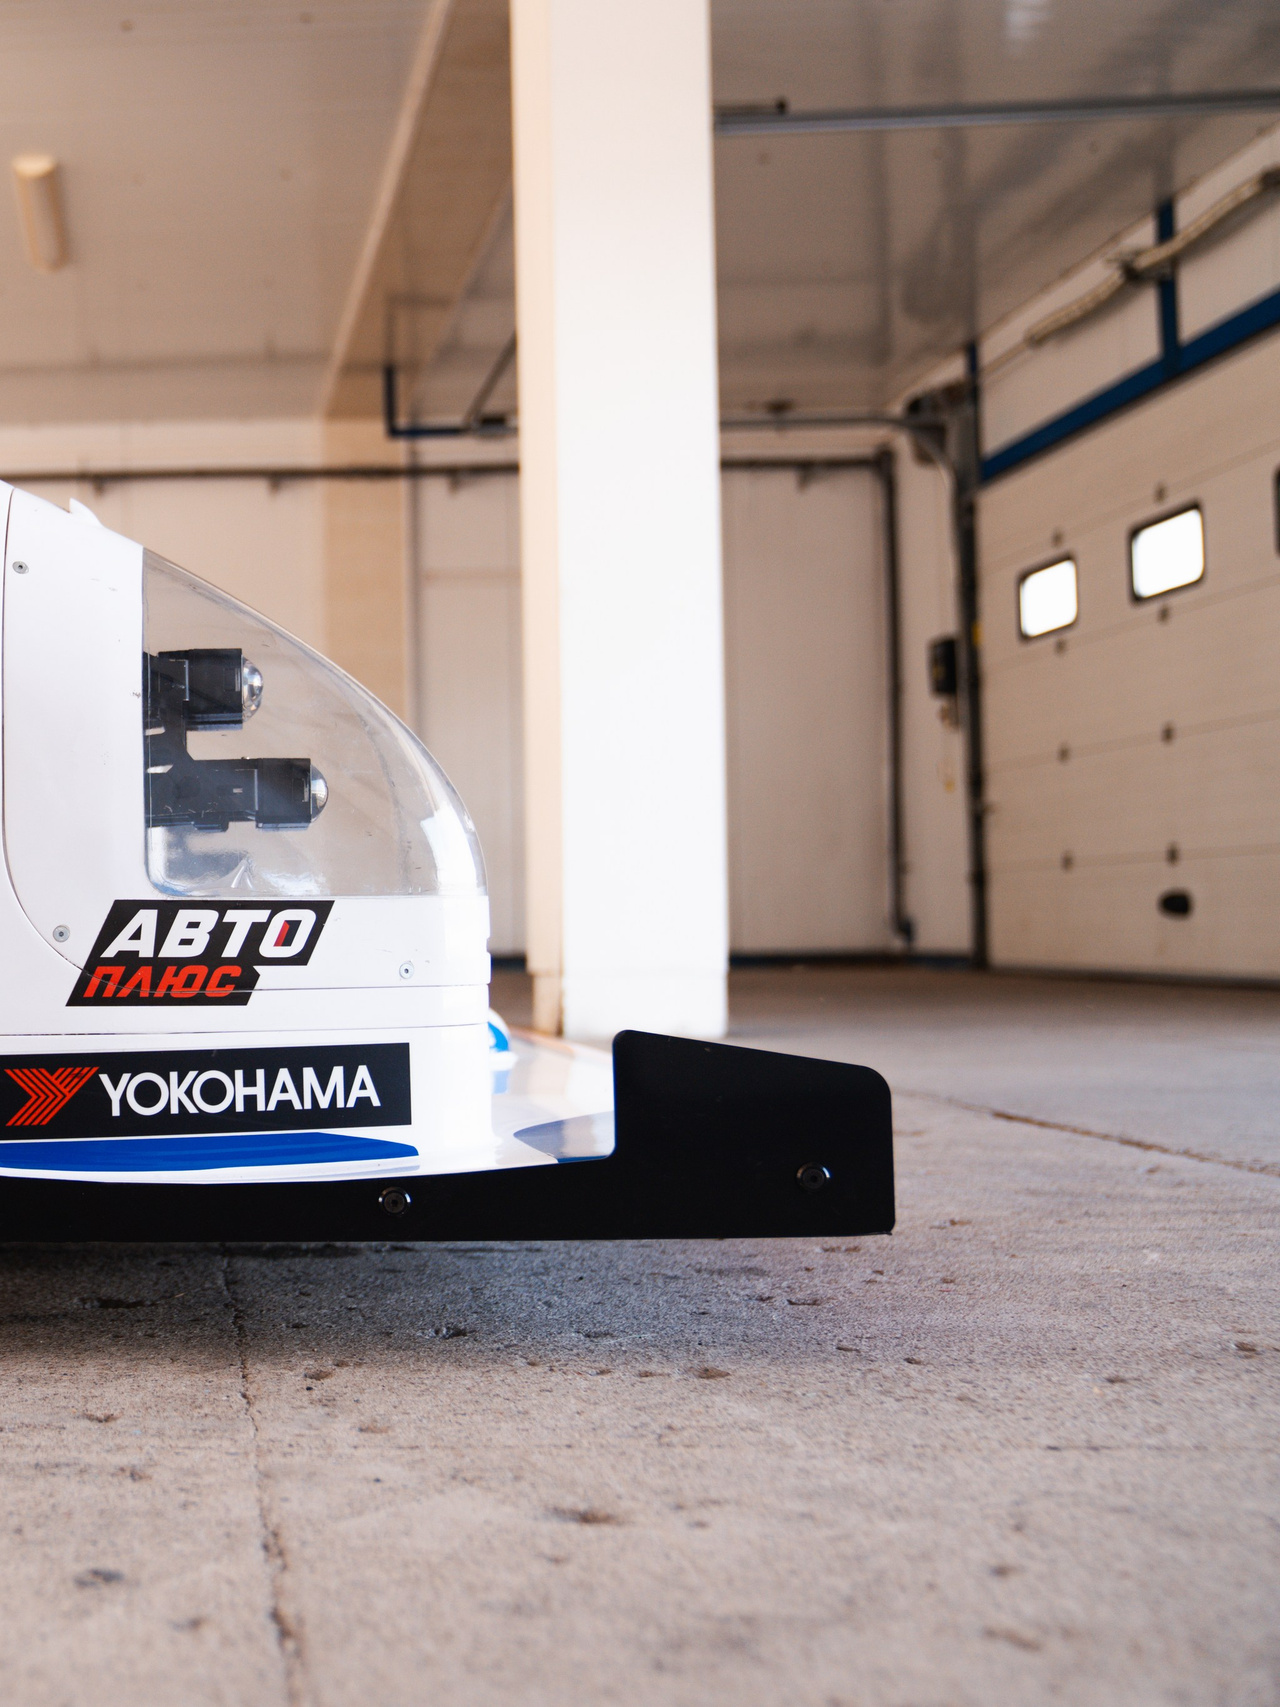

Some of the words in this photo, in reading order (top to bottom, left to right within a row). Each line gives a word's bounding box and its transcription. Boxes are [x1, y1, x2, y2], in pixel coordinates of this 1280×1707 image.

[100, 908, 317, 958] АВТО
[83, 965, 243, 998] ПЛЮС
[98, 1064, 381, 1117] YOKOHAMA
